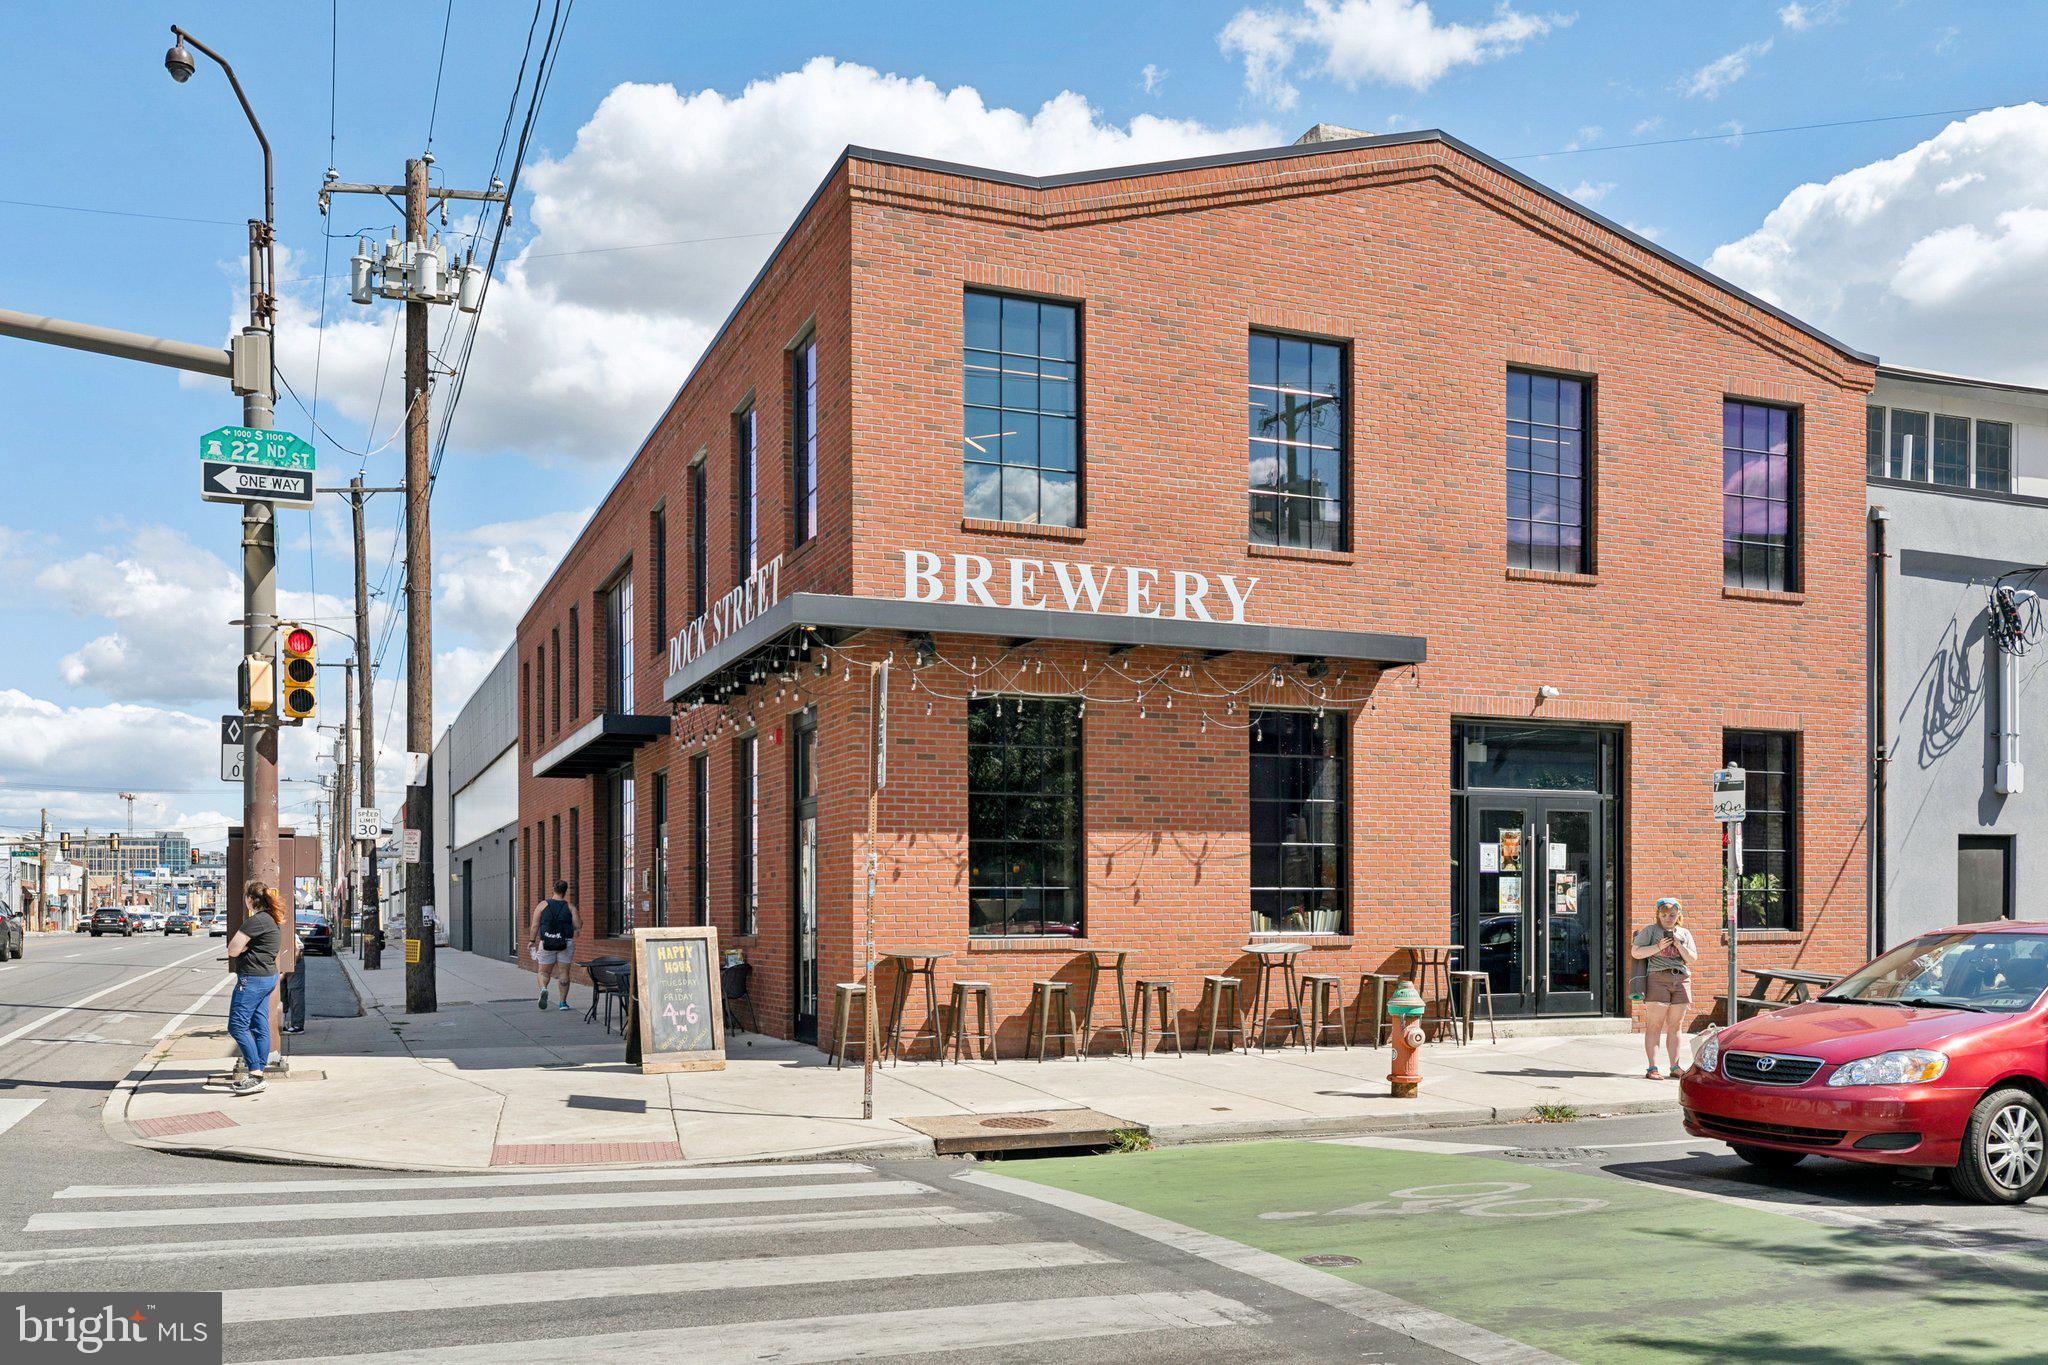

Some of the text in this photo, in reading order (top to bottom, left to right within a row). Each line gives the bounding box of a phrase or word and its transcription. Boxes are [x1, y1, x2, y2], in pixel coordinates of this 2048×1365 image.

[233, 430, 284, 441] 1000 S 1100
[231, 440, 310, 468] 22 ND ST
[239, 474, 300, 491] ONE WAY
[899, 549, 1260, 625] BREWERY
[669, 553, 783, 677] DOCK STREET
[358, 824, 378, 836] 30
[657, 945, 693, 960] HAPPY
[664, 960, 692, 974] HOUR
[660, 979, 697, 988] TUESDAY
[663, 993, 694, 1001] FRIDAY
[662, 1002, 699, 1025] 4-6
[676, 1024, 688, 1032] PM
